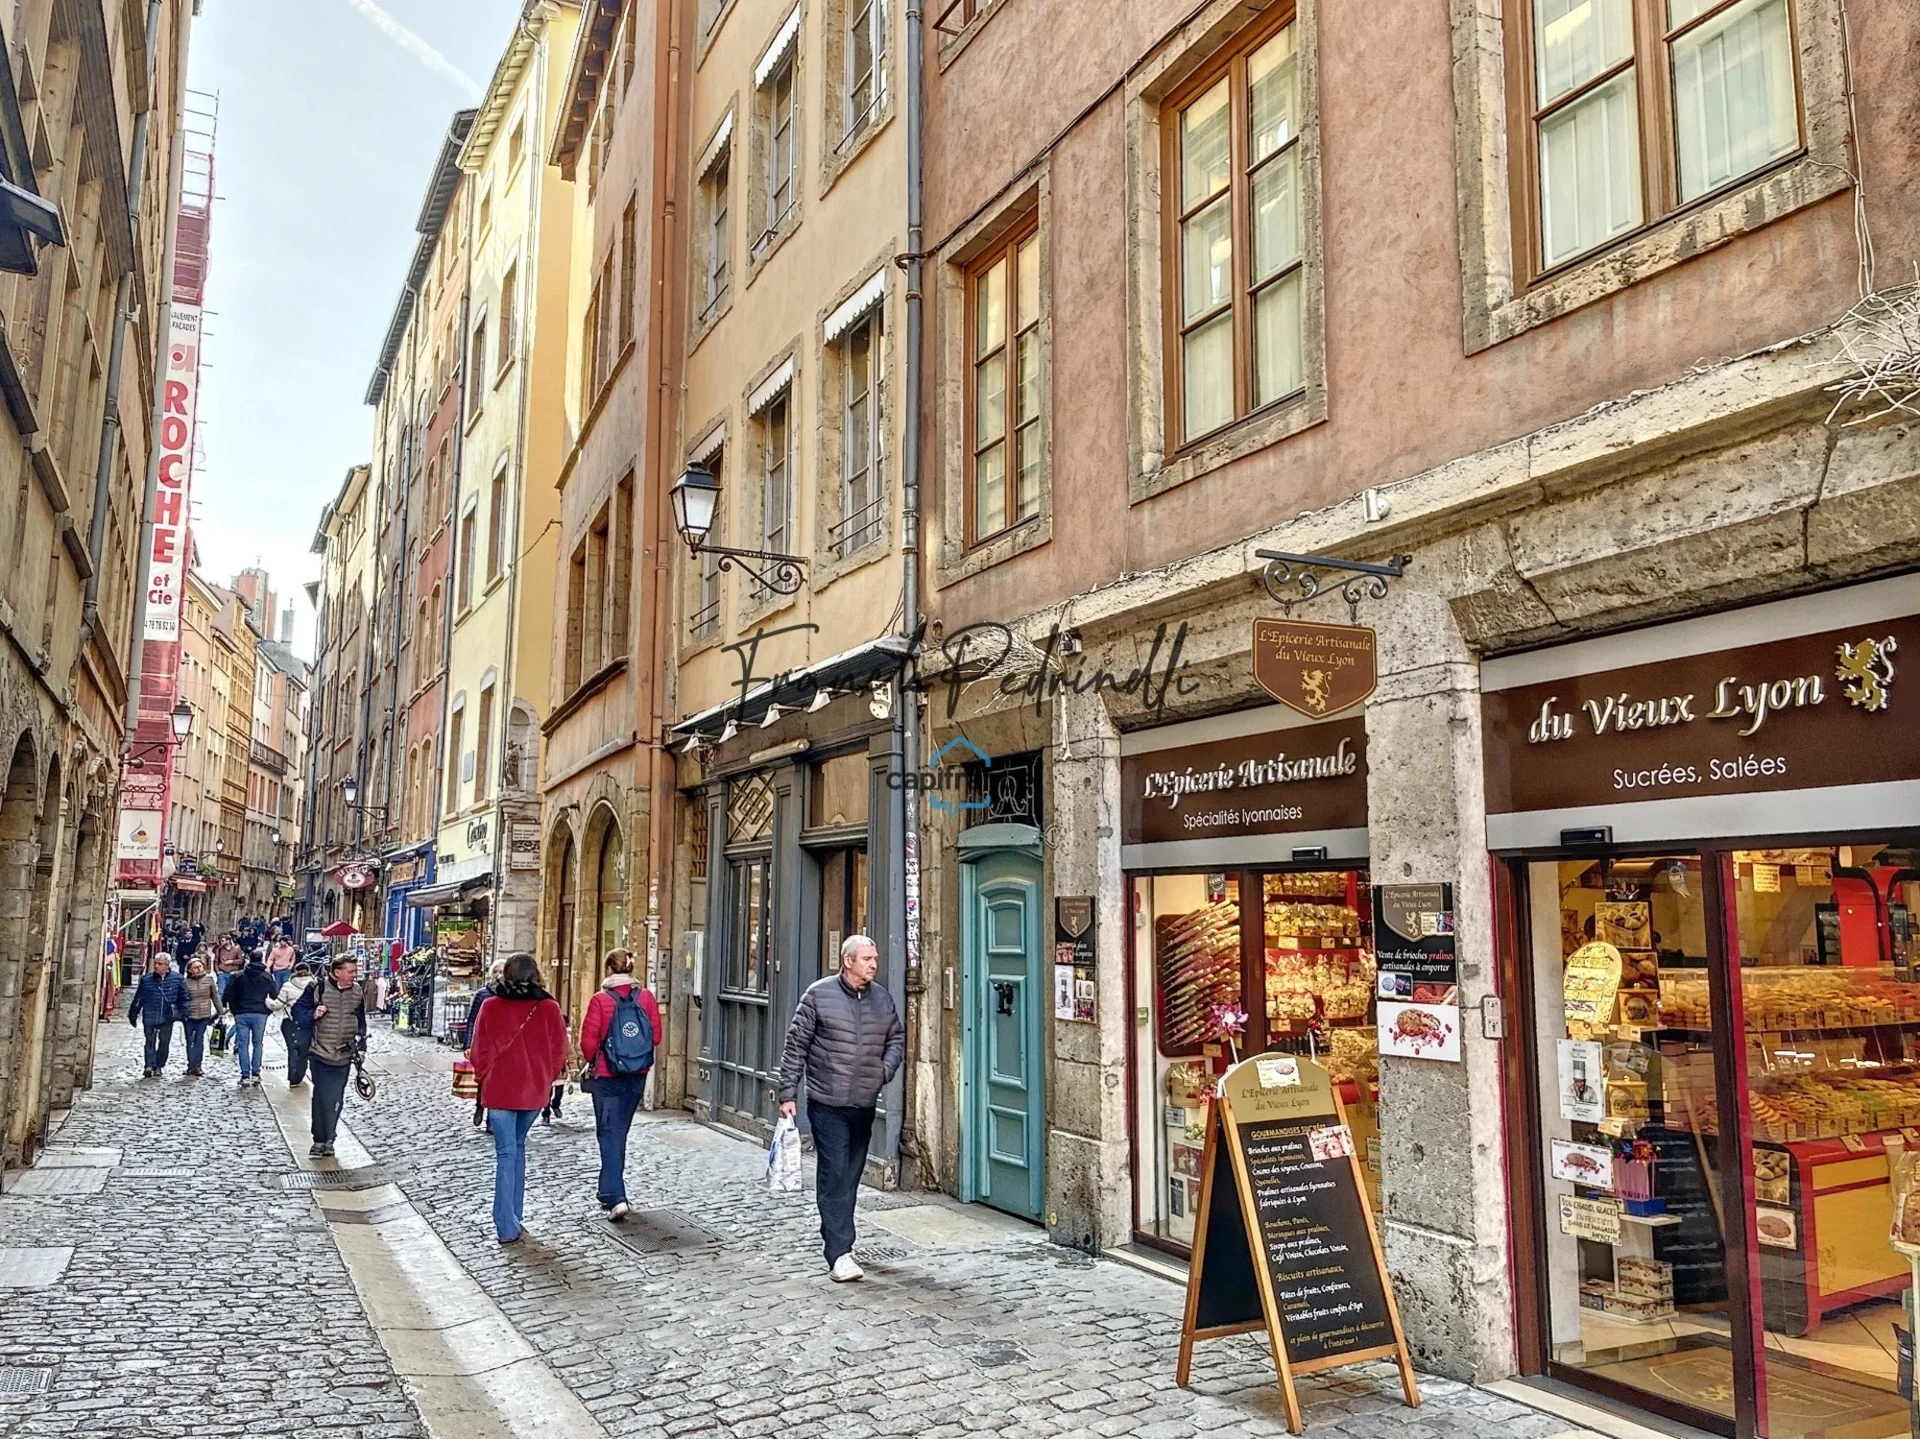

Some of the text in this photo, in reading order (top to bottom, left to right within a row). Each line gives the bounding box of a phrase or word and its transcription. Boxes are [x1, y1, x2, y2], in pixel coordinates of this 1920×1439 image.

[152, 379, 189, 565] ROCHE
[153, 574, 170, 587] et
[148, 589, 172, 605] Cie
[1258, 629, 1371, 651] L'Epicerie Artisanale
[1275, 646, 1355, 670] du Vieux Lyon
[1527, 673, 1825, 744] du Vieux Lyon
[1143, 736, 1357, 810] L'Epicerie Artisanale
[1612, 754, 1787, 789] Sucrées, Salées
[1183, 805, 1302, 831] Spécialités lyonnaises
[1417, 900, 1432, 908] Lyon
[1377, 948, 1454, 964] Vente de brioches pralines
[1382, 960, 1450, 976] artisanales à emporter
[1242, 1081, 1319, 1100] L'Epicerie Artisanale
[1255, 1098, 1310, 1112] du Vieux Lyon
[1251, 1127, 1300, 1138] GOURMANDISES
[1275, 1265, 1345, 1282] Biscuits artisanaux,
